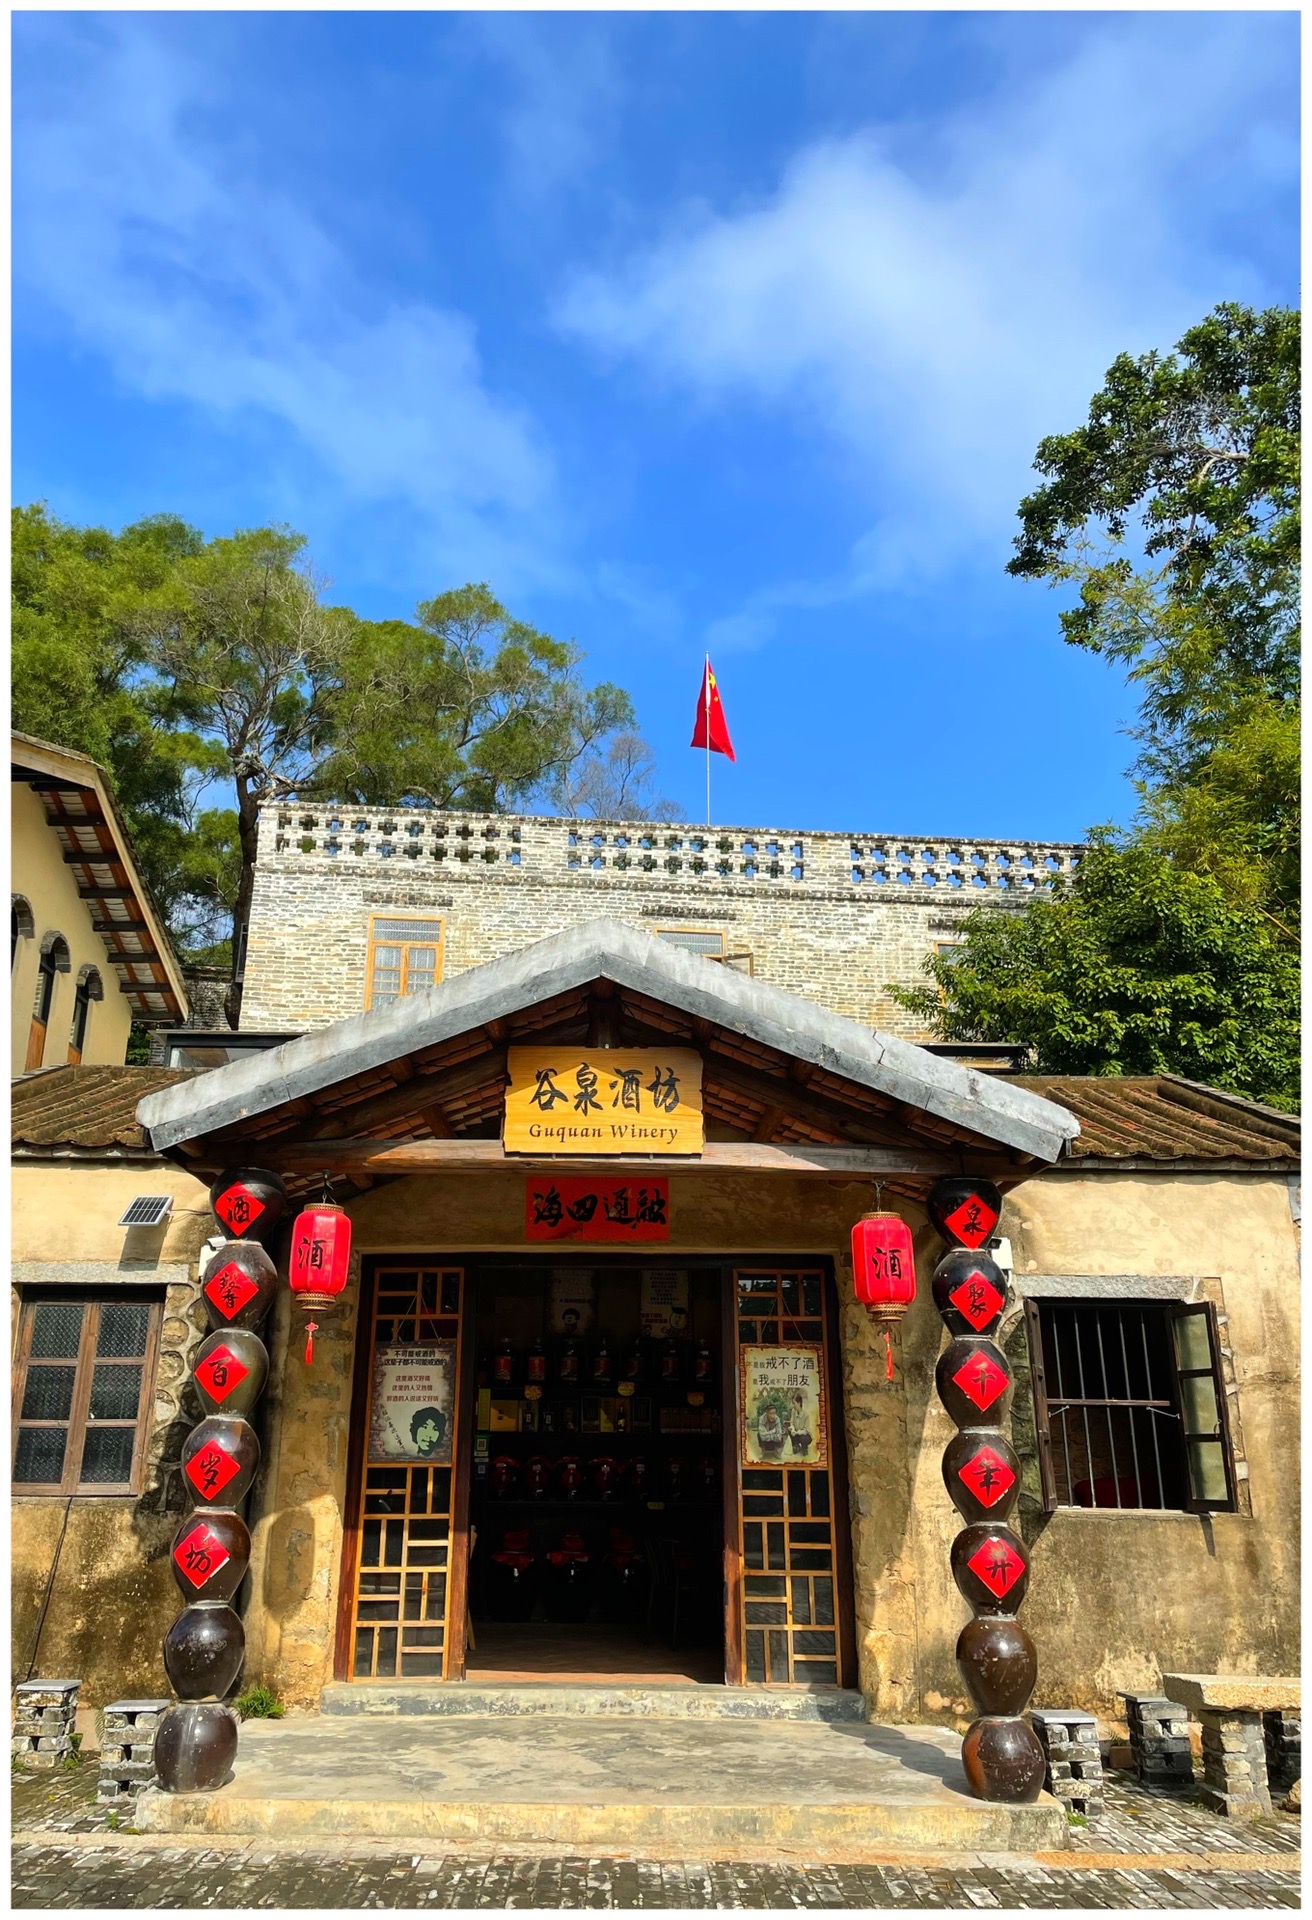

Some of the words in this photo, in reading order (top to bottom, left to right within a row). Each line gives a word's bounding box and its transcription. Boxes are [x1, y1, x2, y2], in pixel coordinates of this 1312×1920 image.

[529, 1062, 681, 1117] 谷泉酒坊
[529, 1123, 603, 1143] Guquan
[610, 1124, 678, 1144] Winery
[227, 1194, 250, 1223] 酒
[963, 1203, 987, 1236] 泉
[298, 1237, 327, 1271] 酒
[871, 1247, 902, 1280] 酒
[209, 1356, 232, 1387] 百
[972, 1362, 996, 1398] 千
[200, 1452, 221, 1491] 岁
